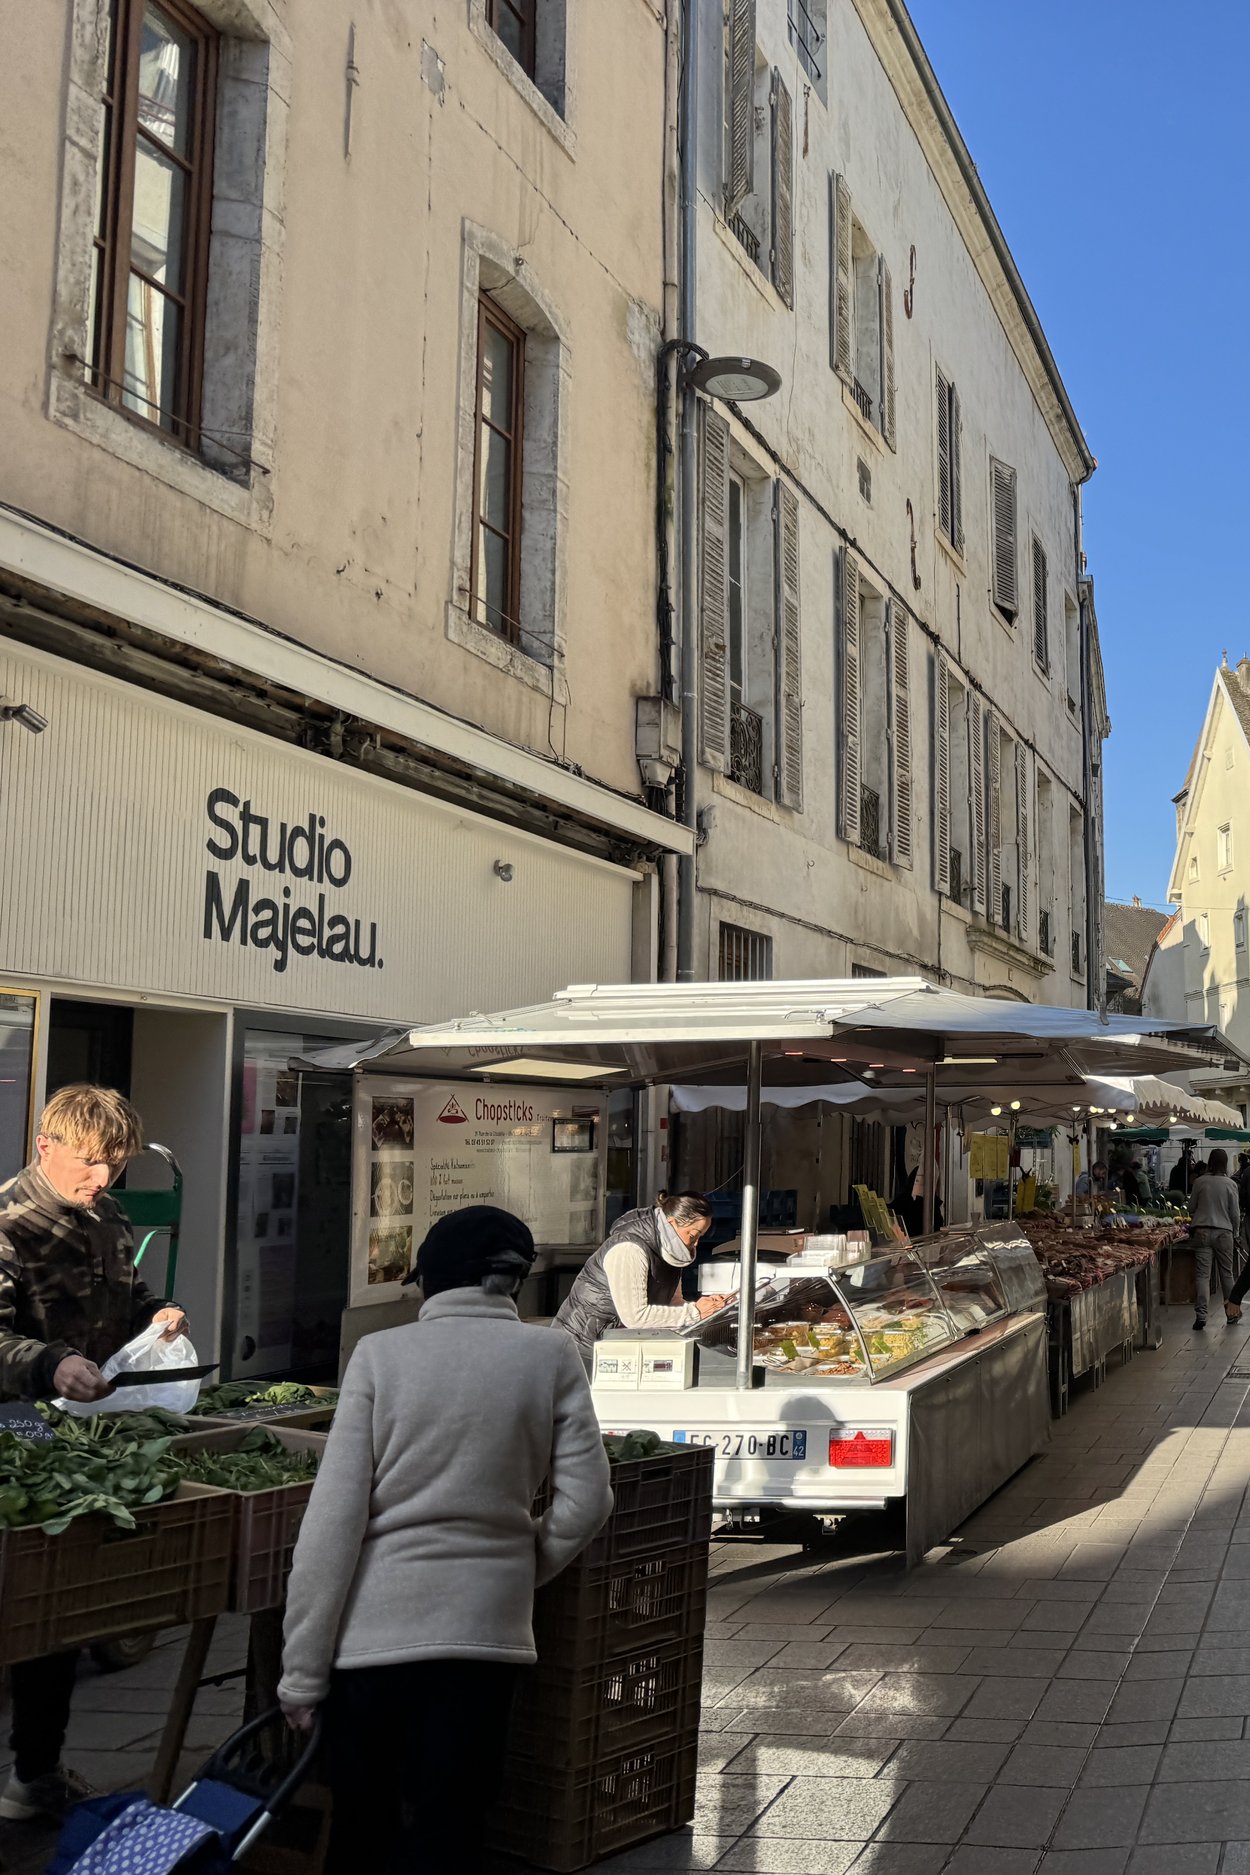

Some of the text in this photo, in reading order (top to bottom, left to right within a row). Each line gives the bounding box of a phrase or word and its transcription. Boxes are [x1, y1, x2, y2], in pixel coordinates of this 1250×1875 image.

[206, 787, 352, 888] Studio
[203, 870, 384, 973] Majelau.
[475, 1098, 534, 1125] Chopsticks
[793, 1446, 805, 1457] 42
